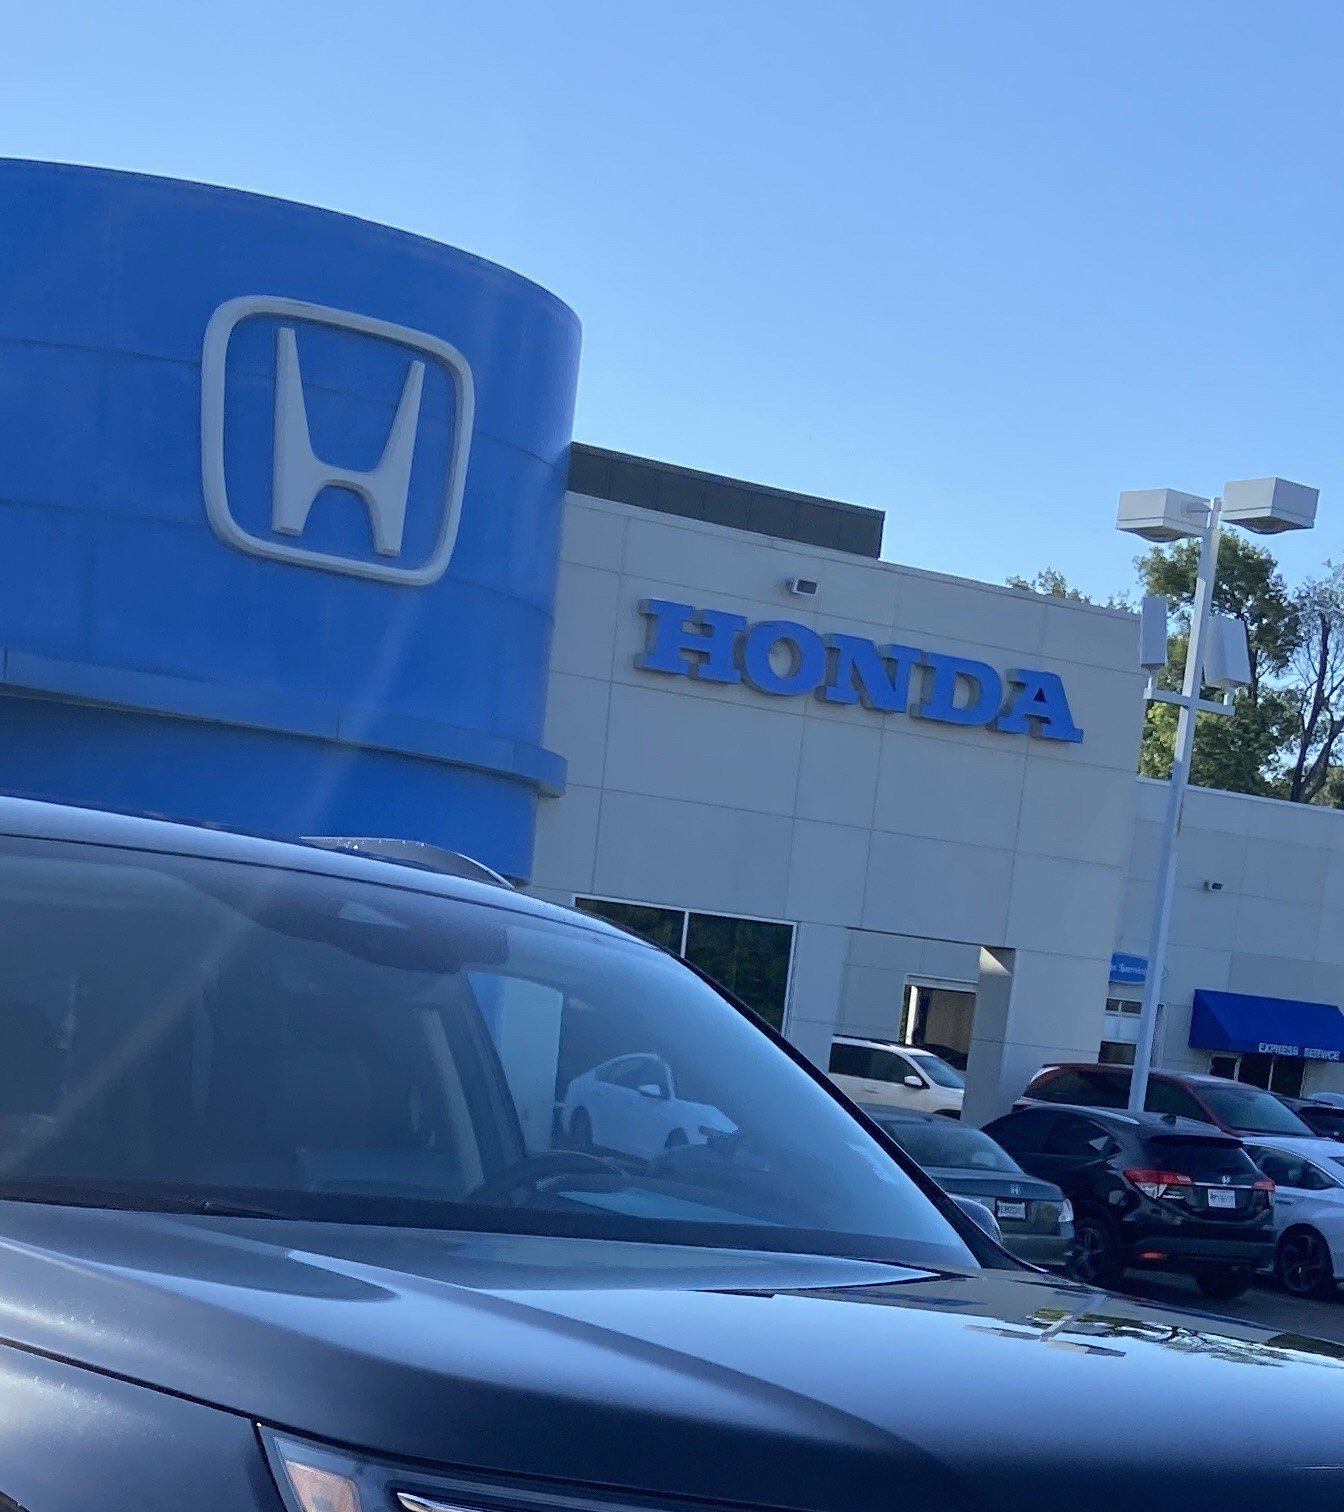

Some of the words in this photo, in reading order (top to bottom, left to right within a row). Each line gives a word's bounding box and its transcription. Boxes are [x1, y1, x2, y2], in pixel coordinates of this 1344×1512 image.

[634, 597, 1084, 743] HONDA
[1259, 1042, 1299, 1056] EXPRESS
[1304, 1047, 1341, 1061] SERVICE
